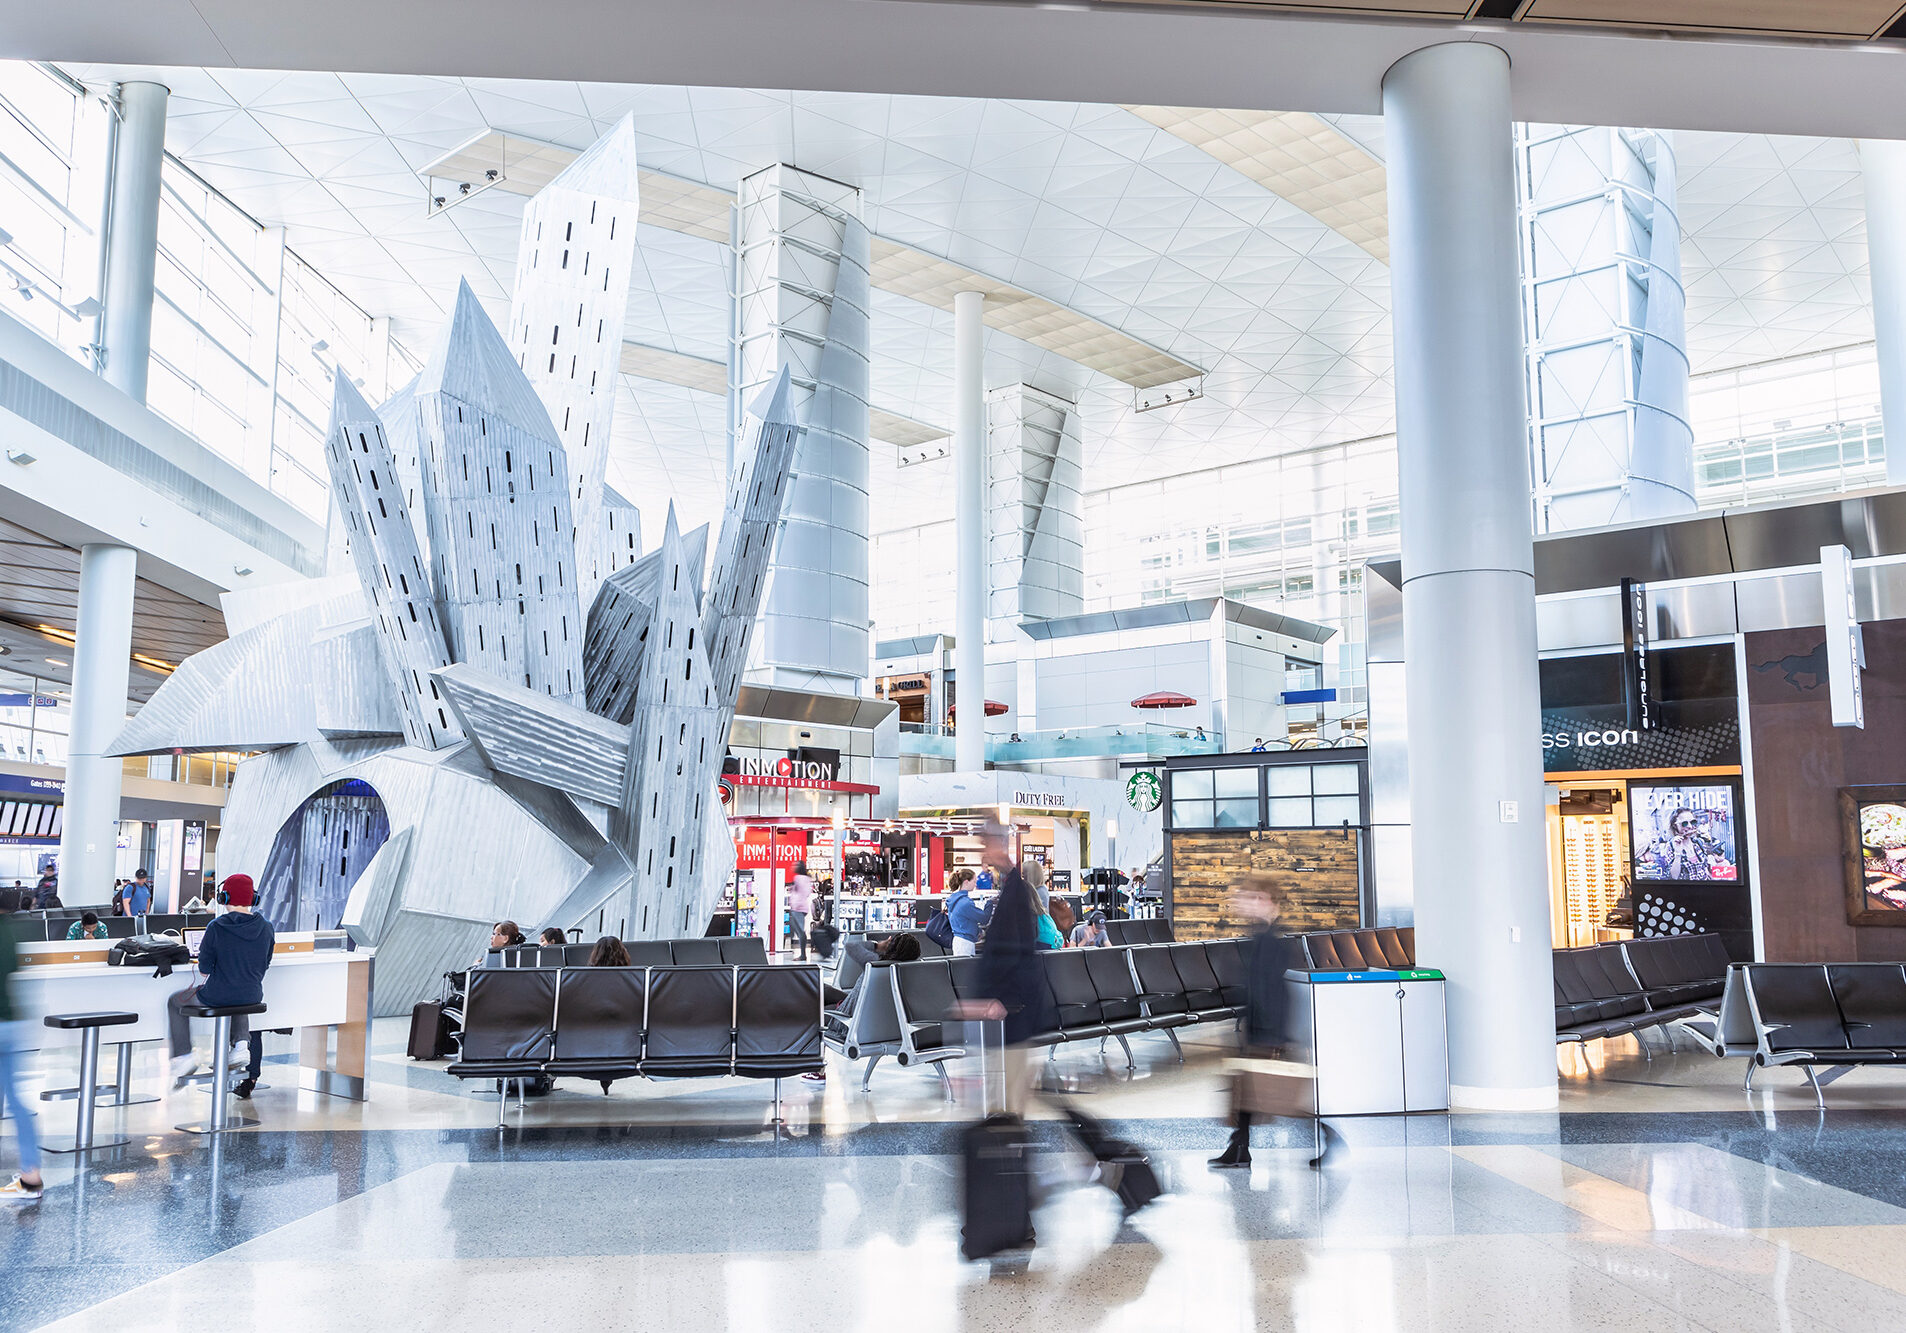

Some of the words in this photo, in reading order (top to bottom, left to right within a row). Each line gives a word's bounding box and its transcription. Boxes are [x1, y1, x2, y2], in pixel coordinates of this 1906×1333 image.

[740, 776, 831, 788] ENTERTAINMENT
[1015, 791, 1041, 805] DUTY
[1042, 793, 1065, 806] FREE
[1689, 791, 1727, 810] HIDE
[743, 844, 802, 857] INMTION
